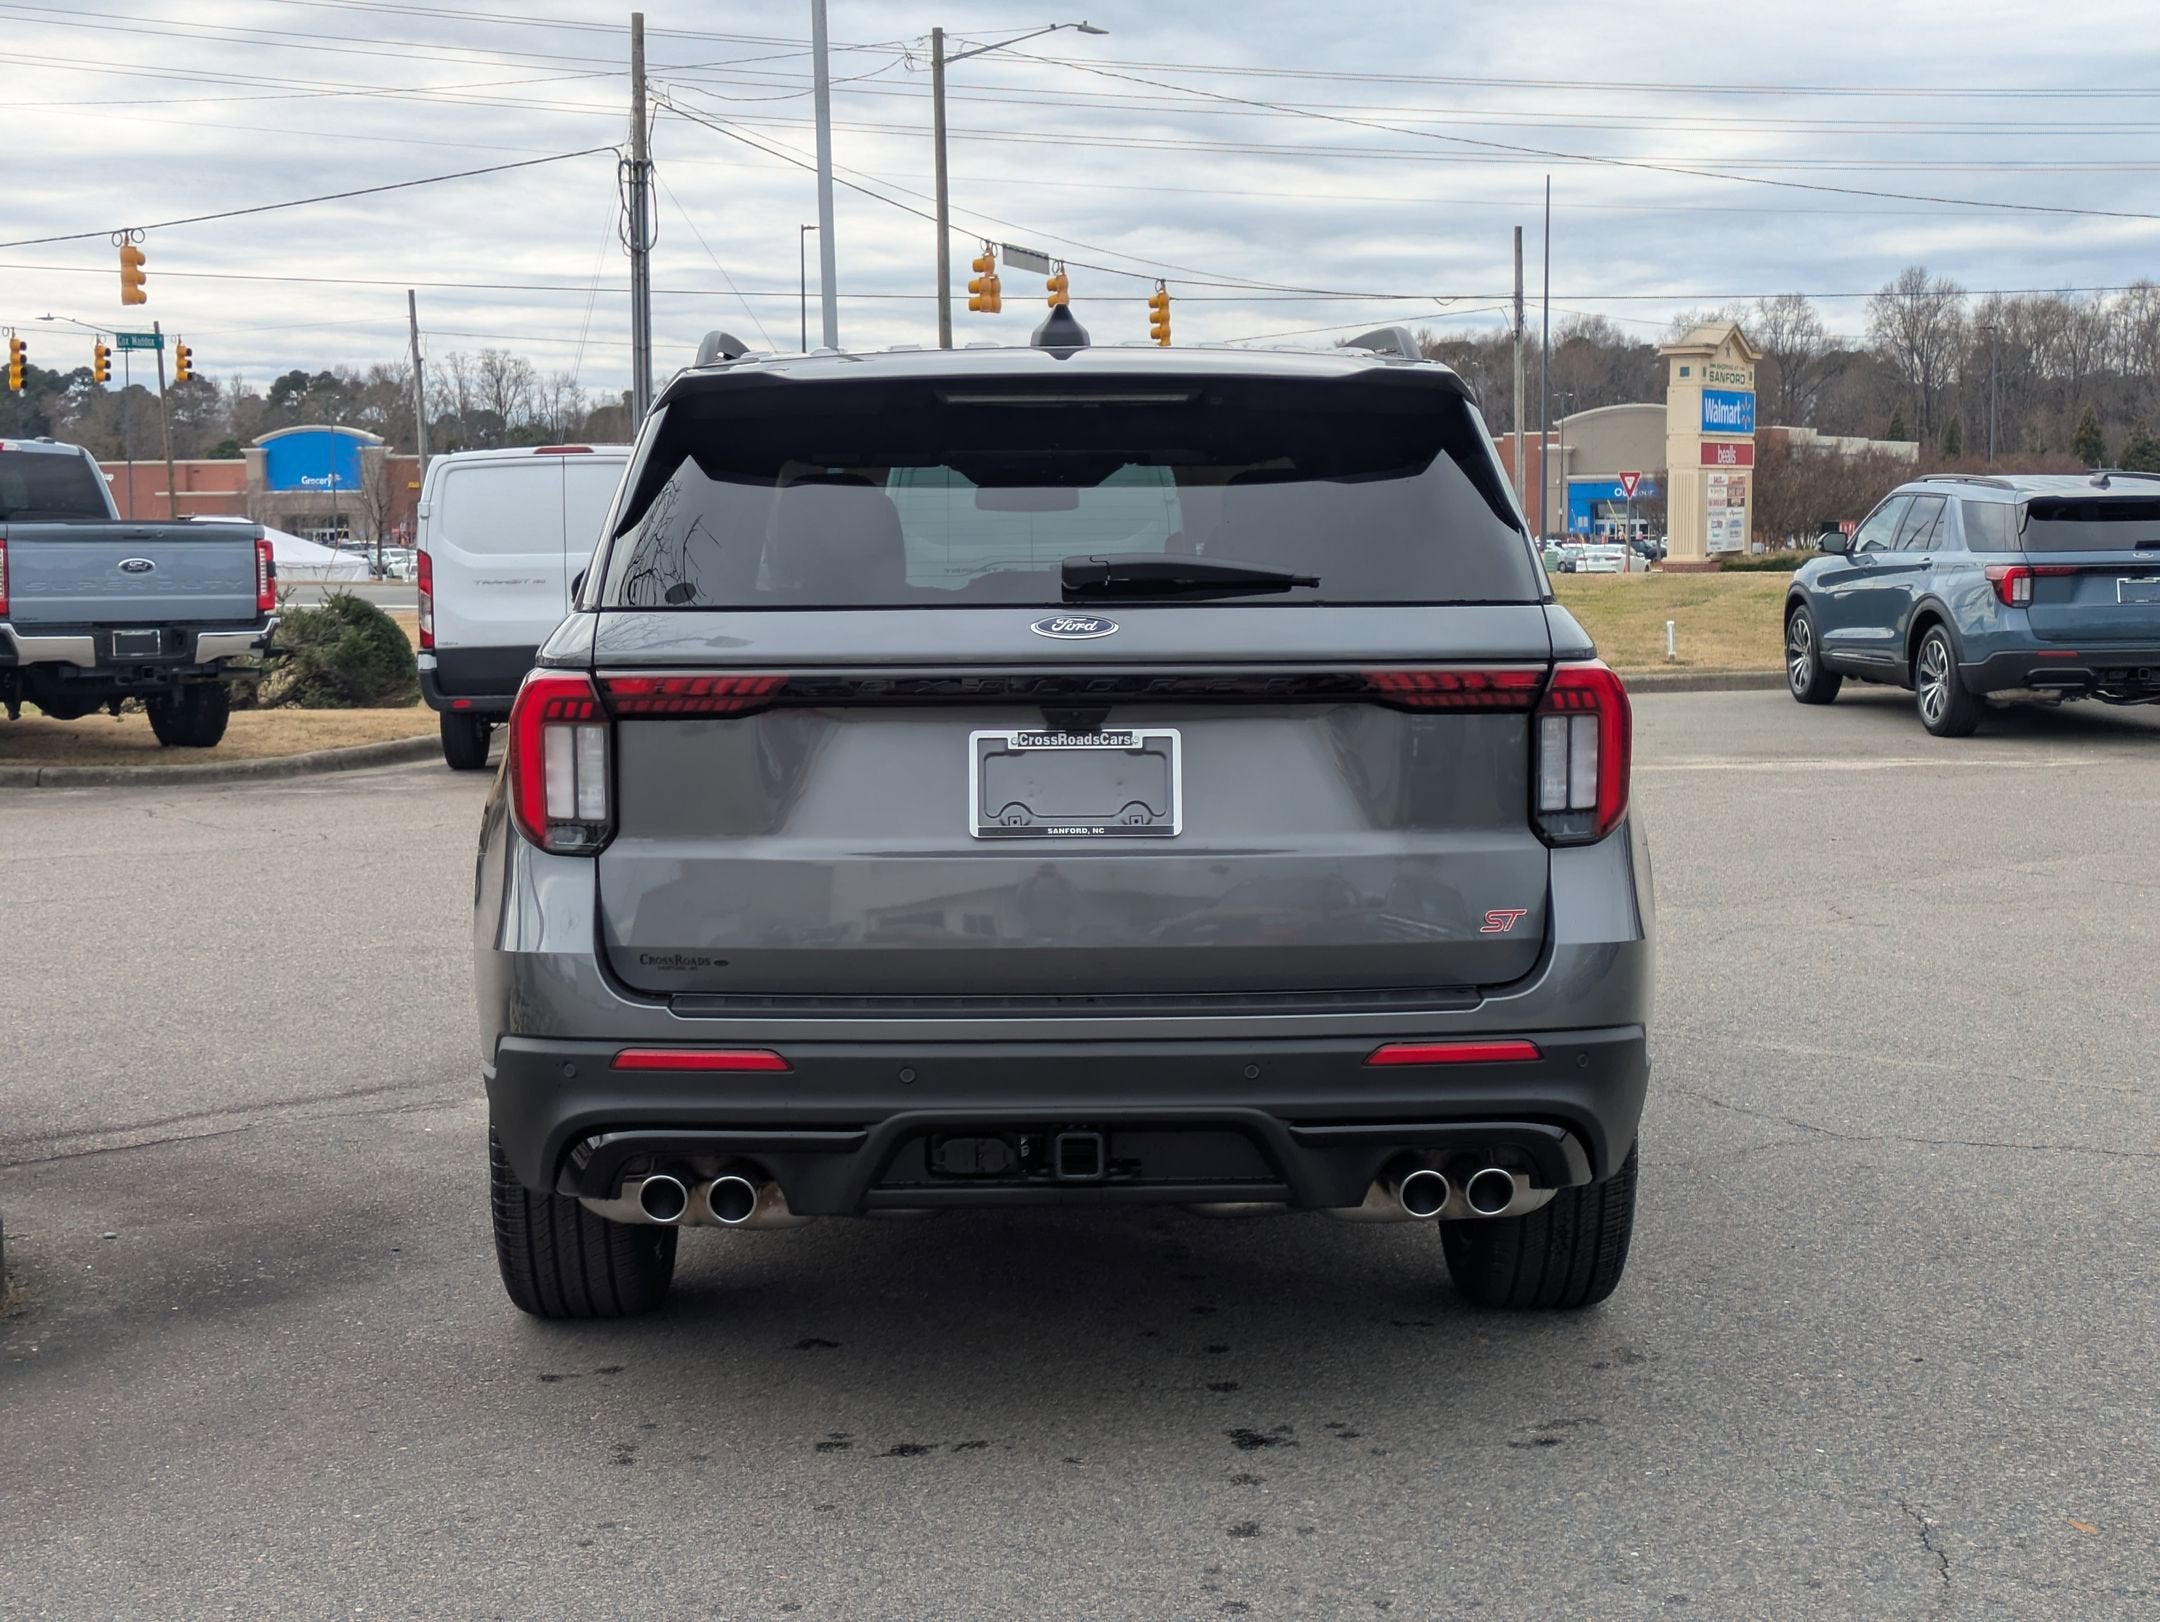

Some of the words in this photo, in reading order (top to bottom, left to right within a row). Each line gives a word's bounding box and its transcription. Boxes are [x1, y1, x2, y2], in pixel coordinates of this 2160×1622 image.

[1709, 370, 1746, 385] SANFORD
[1704, 397, 1741, 425] Walmart
[1717, 444, 1737, 464] bealls
[301, 475, 332, 487] Grocery
[1614, 487, 1655, 497] Oudoor
[1051, 618, 1098, 632] Ford
[1019, 732, 1132, 746] CrossRoadsCars
[1047, 827, 1090, 835] SANFORD,
[1480, 908, 1528, 933] ST
